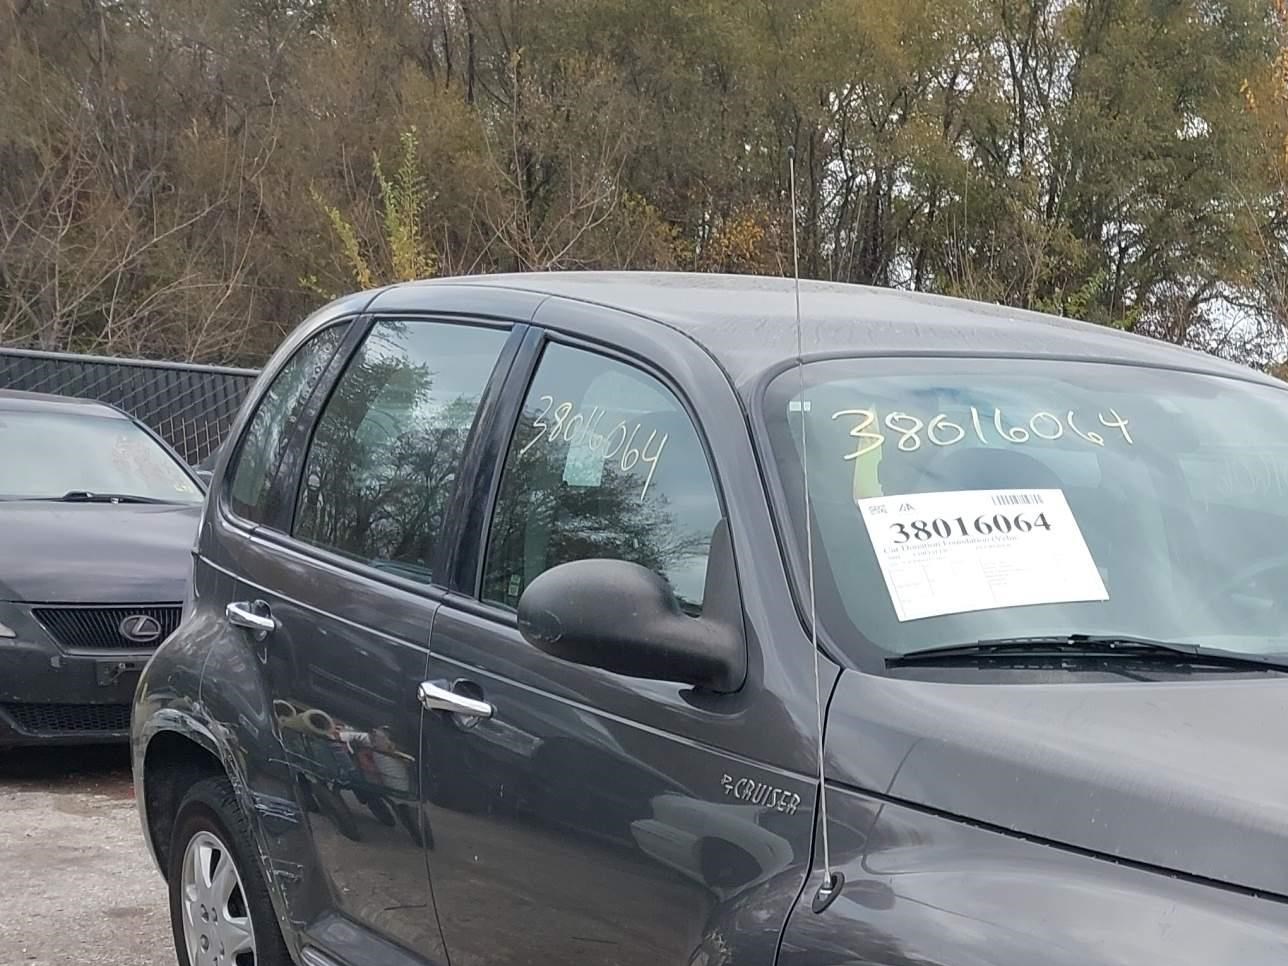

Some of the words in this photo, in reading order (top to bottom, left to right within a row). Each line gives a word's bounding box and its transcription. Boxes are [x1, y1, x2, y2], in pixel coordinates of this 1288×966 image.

[520, 396, 668, 501] 38016064
[833, 407, 1134, 460] 38016064
[890, 512, 1051, 543] 38016064
[735, 778, 801, 815] CRUISER
